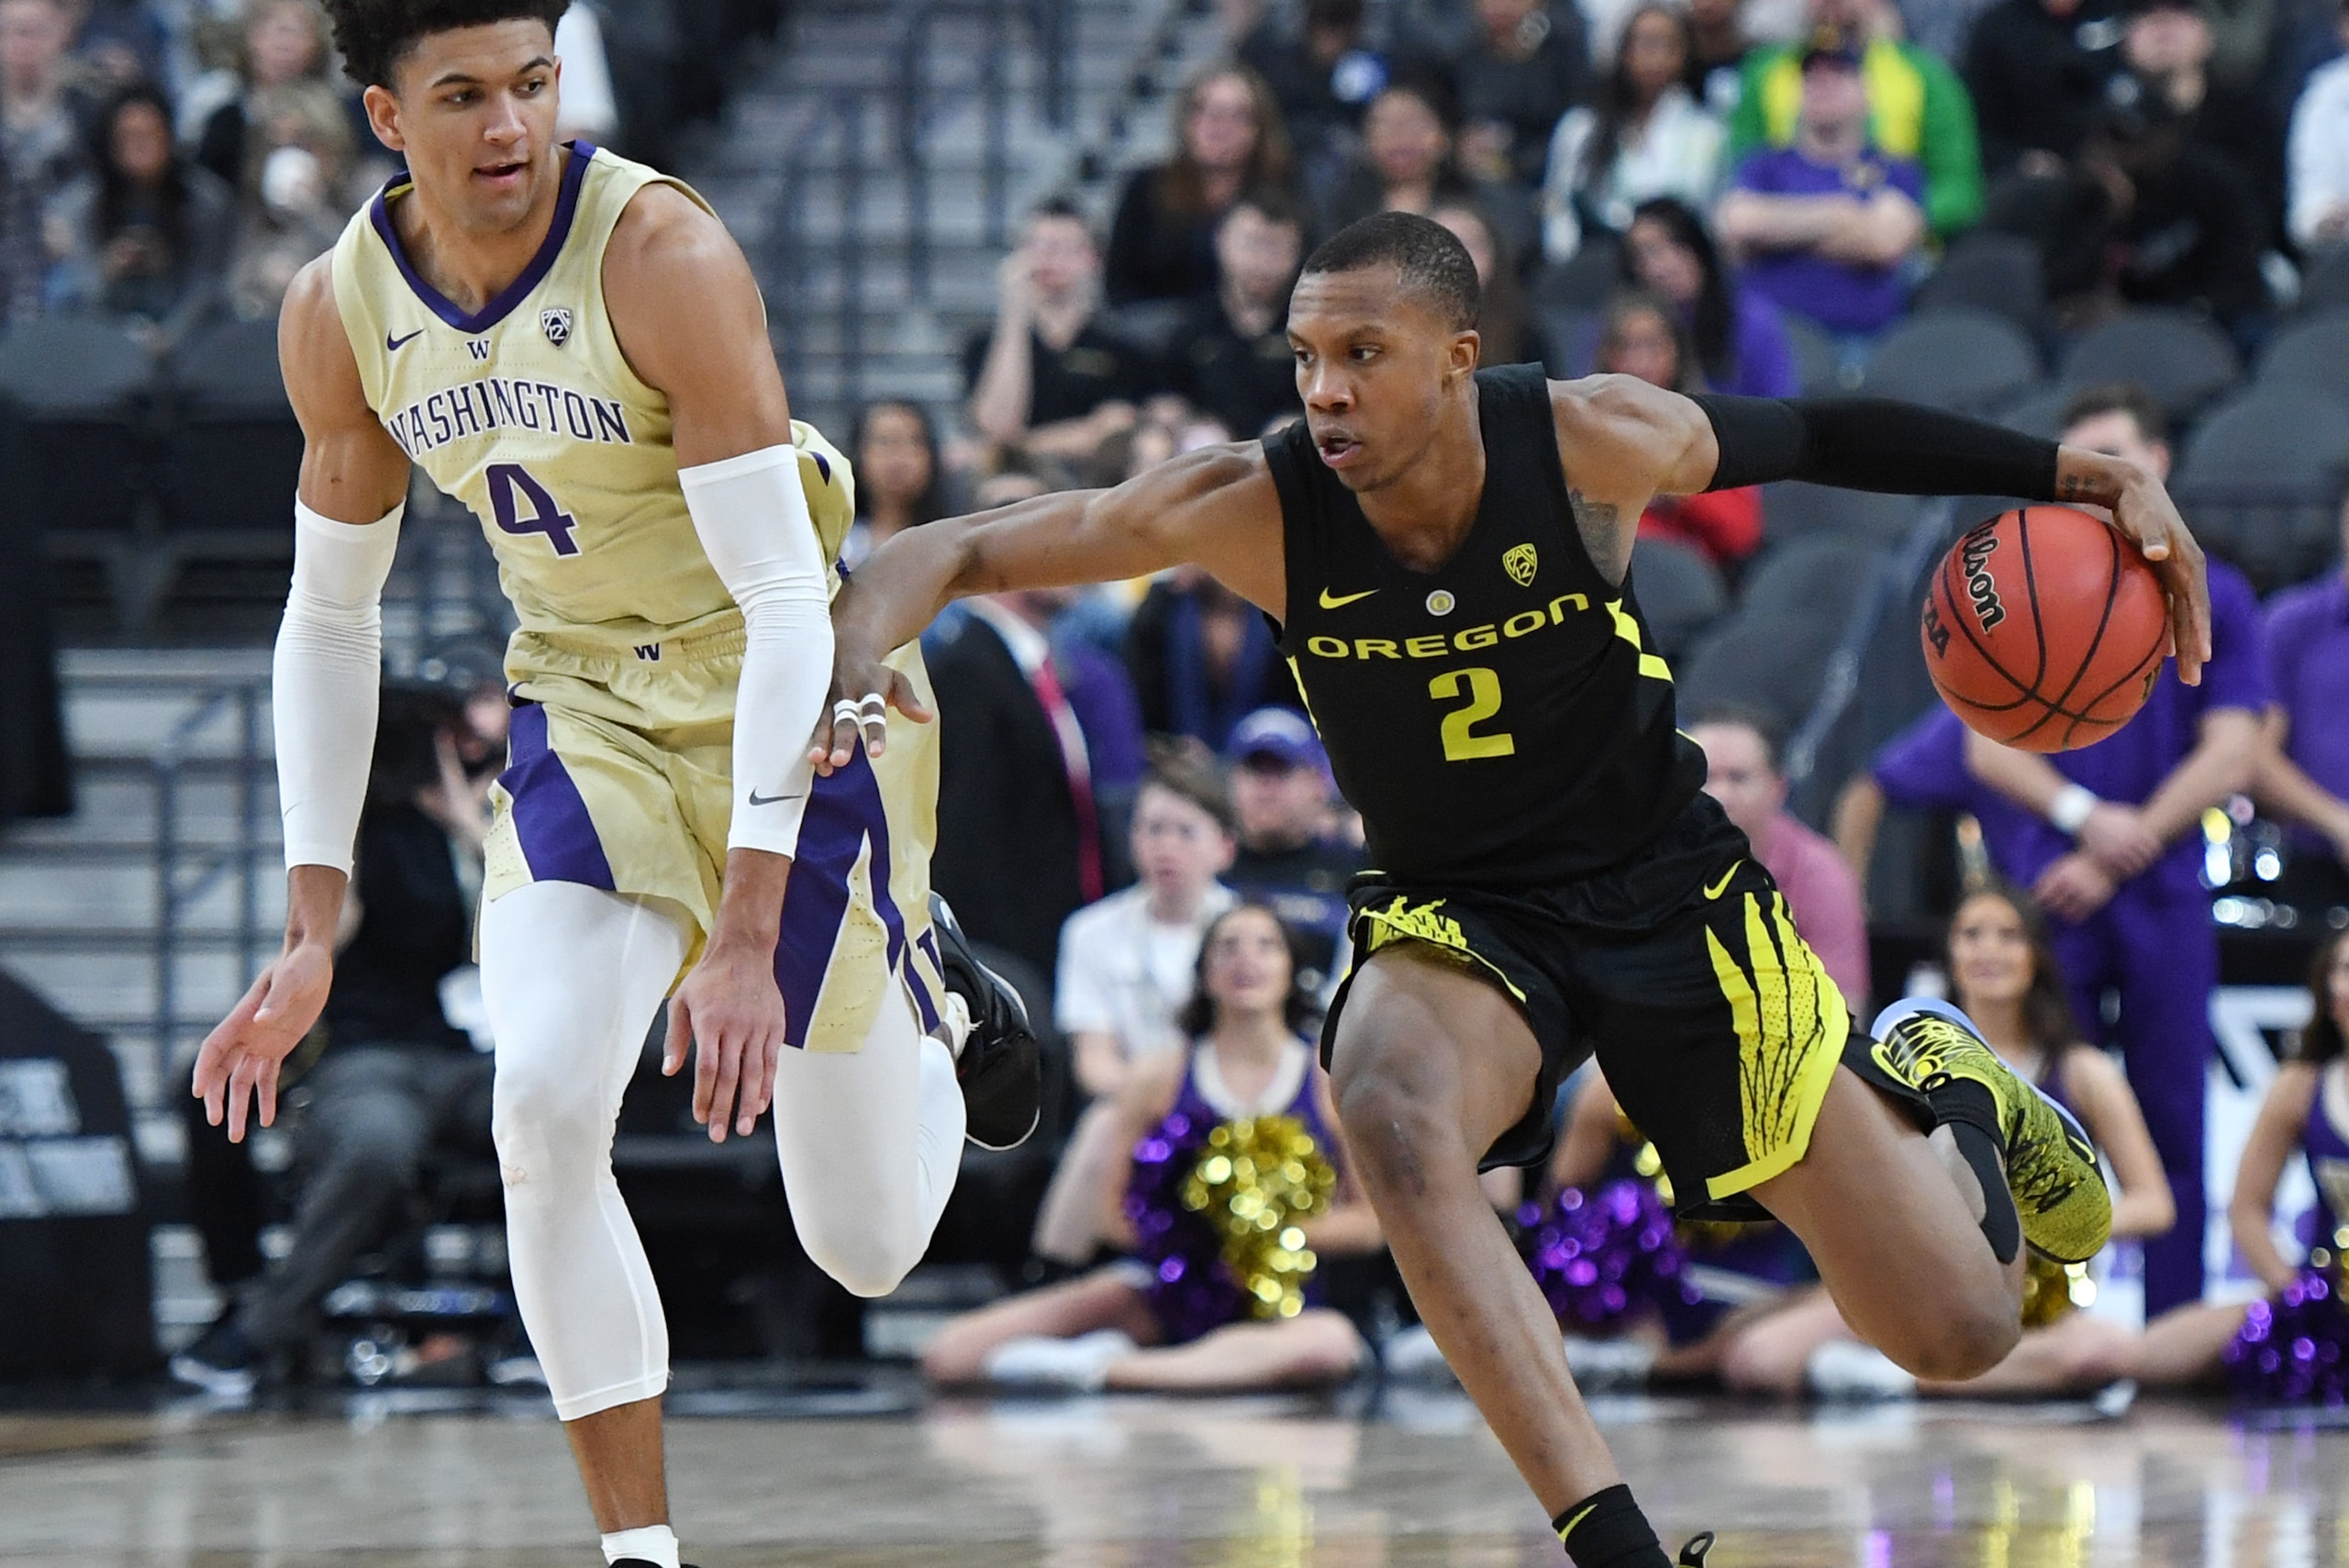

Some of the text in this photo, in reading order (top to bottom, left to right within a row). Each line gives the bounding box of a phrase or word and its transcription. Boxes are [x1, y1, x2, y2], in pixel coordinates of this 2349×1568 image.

[540, 308, 571, 332] PAC
[549, 324, 565, 339] 12
[466, 339, 490, 360] W
[385, 377, 633, 458] WASHINGTON
[485, 462, 583, 559] 4
[1505, 546, 1536, 574] PAC
[1515, 562, 1532, 580] 12
[1307, 592, 1589, 660] OREGON
[633, 641, 661, 662] W
[1429, 667, 1515, 762] 2
